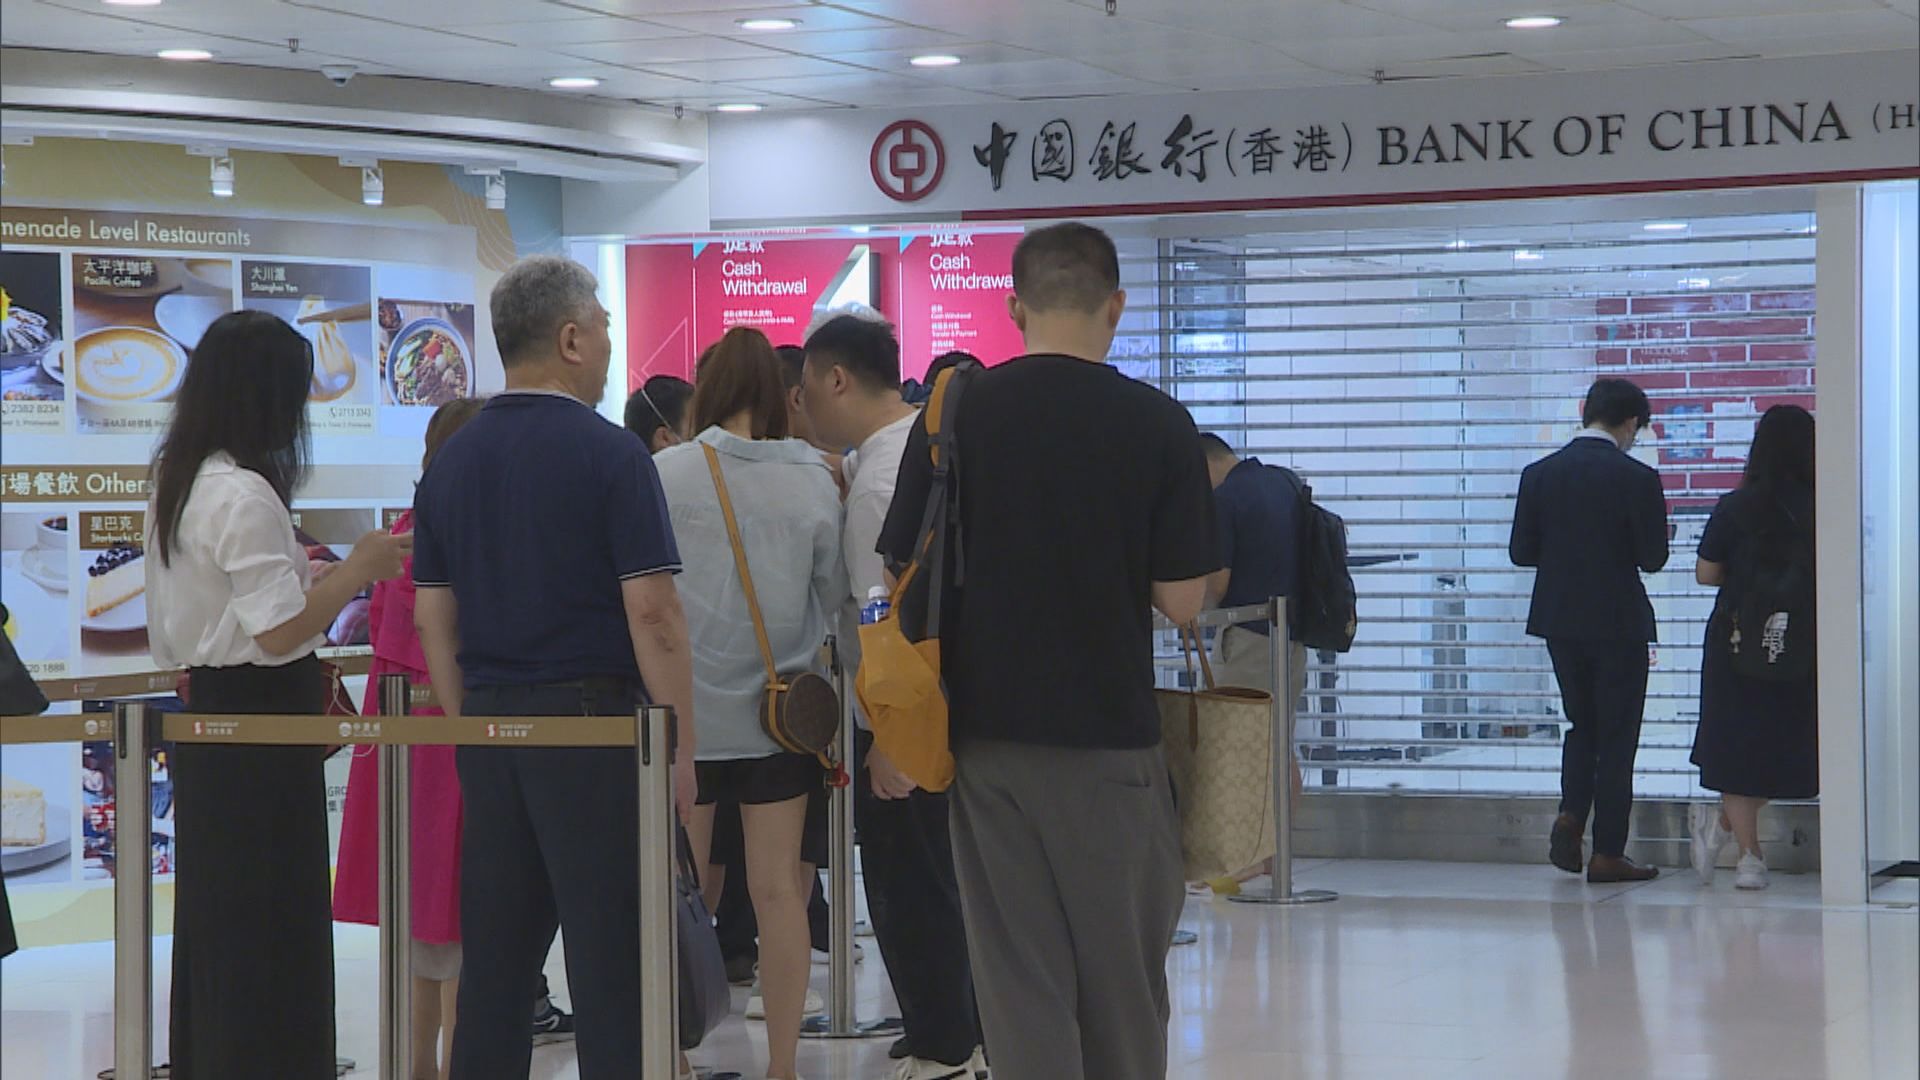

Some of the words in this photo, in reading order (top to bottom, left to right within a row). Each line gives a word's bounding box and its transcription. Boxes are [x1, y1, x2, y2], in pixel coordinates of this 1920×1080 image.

[1377, 119, 1535, 166] BANK
[1553, 113, 1626, 157] OF
[1647, 100, 1851, 152] CHINA
[973, 113, 1352, 192] 中國銀行(香港)
[90, 219, 139, 241] Level
[146, 222, 251, 246] Restaurants
[83, 258, 154, 277] 太平洋咖啡
[722, 259, 762, 277] Cash
[930, 253, 971, 271] Cash
[84, 276, 111, 286] Pacific
[113, 276, 142, 288] Coffee
[722, 277, 807, 297] Withdrawal
[929, 272, 1014, 291] Withdrawa
[2, 472, 80, 496] 場餐飲
[90, 515, 133, 531] 星巴克
